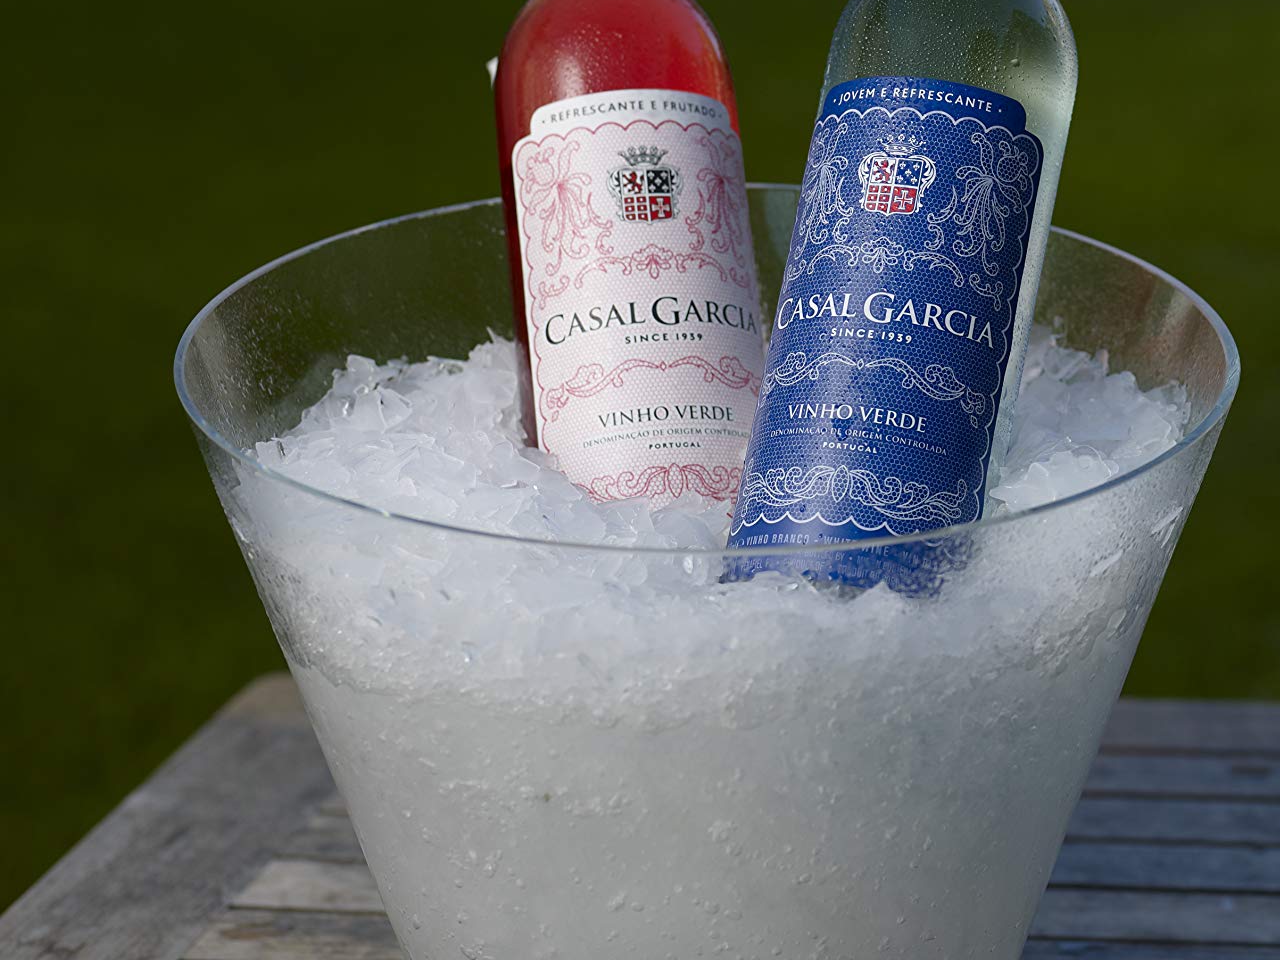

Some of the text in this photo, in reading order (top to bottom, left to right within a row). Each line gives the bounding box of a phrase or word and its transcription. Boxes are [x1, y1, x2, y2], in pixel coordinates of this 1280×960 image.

[550, 100, 717, 123] REFRESCANTE E FRUTADO
[838, 87, 993, 113] JOVEM E REFRESCANTE
[544, 296, 758, 346] CASAL GARCIA
[777, 290, 995, 349] CASAL GARCIA
[625, 332, 703, 345] SINCE 1939
[830, 327, 912, 344] SINCE 1939
[598, 404, 735, 428] VINHO VERDE
[788, 403, 928, 433] VINHO VERDE
[653, 428, 665, 437] DE
[668, 427, 702, 437] ORIGEM
[830, 427, 842, 437] DE
[844, 427, 884, 440] ORIGEM
[885, 433, 948, 456] CONTROLADA
[648, 441, 702, 450] PORTUGAL
[822, 441, 878, 454] PORTUGAL
[746, 534, 769, 547] VINHO
[771, 533, 810, 545] BRANCO
